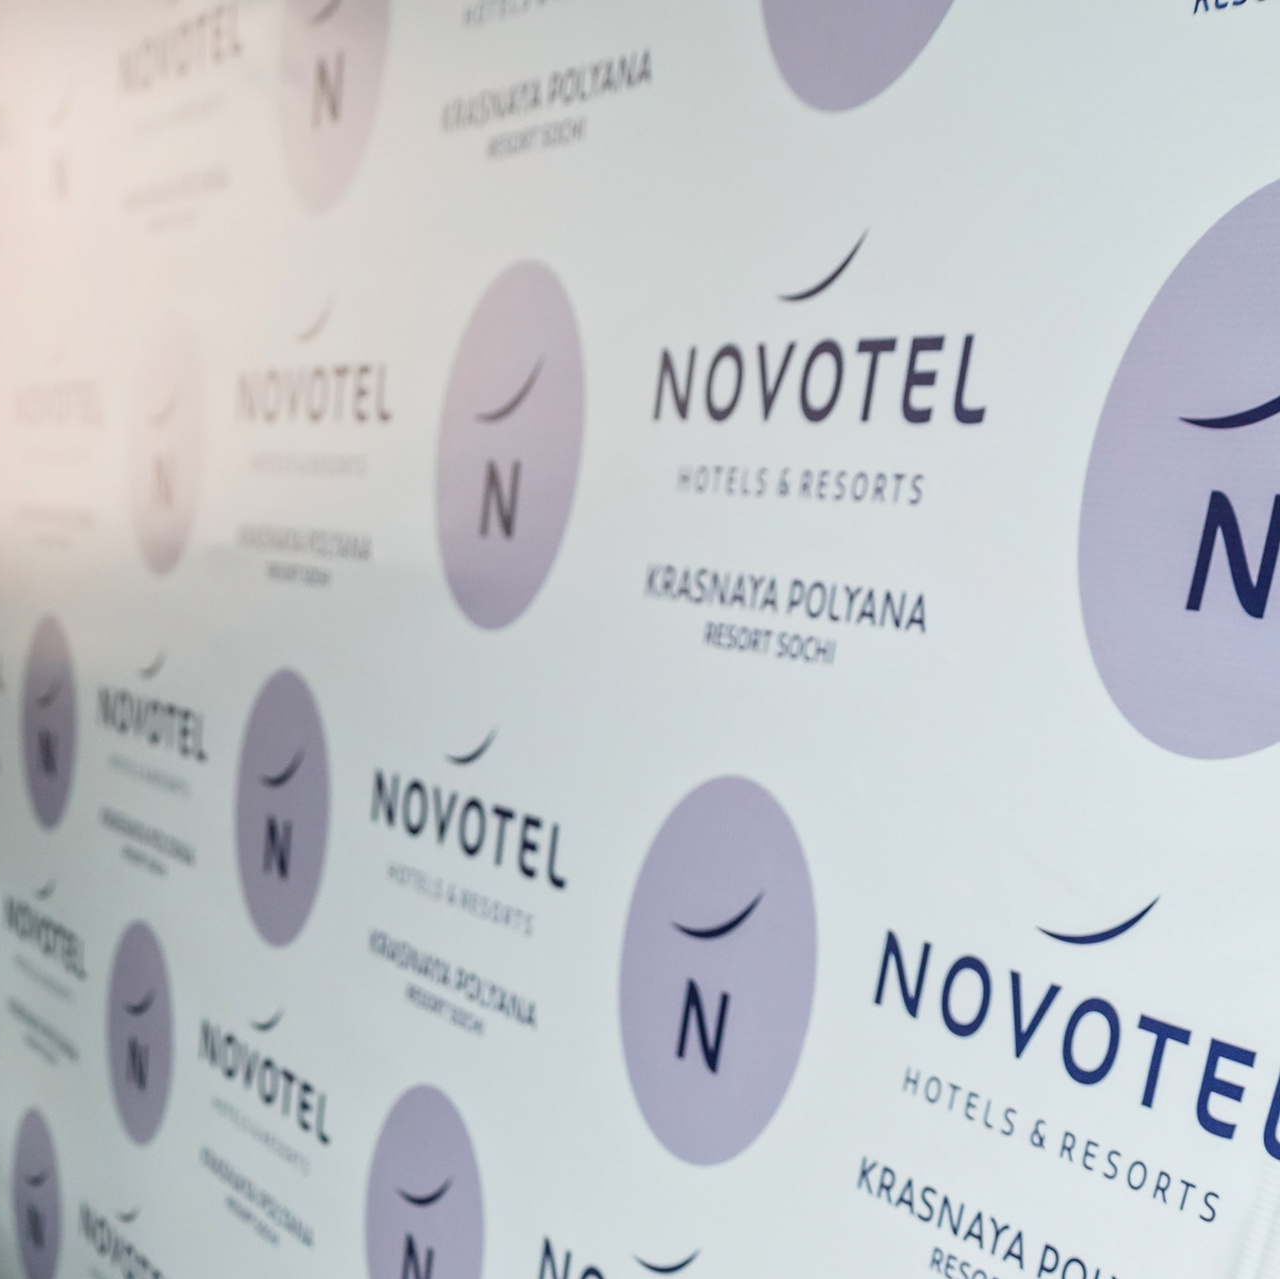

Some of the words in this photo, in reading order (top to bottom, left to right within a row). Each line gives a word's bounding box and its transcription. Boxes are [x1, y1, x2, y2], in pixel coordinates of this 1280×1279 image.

[235, 361, 392, 426] NOVOTEL
[653, 333, 987, 424] NOVOTEL
[480, 459, 522, 539] N
[676, 465, 768, 497] HOTELS
[800, 469, 924, 505] RESORTS
[644, 562, 779, 613] KRASNAYA
[786, 578, 927, 633] POLYANA
[1186, 490, 1280, 619] N
[704, 620, 774, 653] RESORT
[775, 630, 837, 665] SOCHI
[262, 813, 293, 879] N
[370, 768, 566, 890] NOVOTEL
[677, 978, 730, 1075] N
[198, 1016, 331, 1147] NOVOTEL
[902, 1065, 1018, 1137] HOTELS
[1030, 1120, 1047, 1149] &
[1059, 1131, 1220, 1223] RESORTS
[856, 1155, 1025, 1271] KRASNAYA
